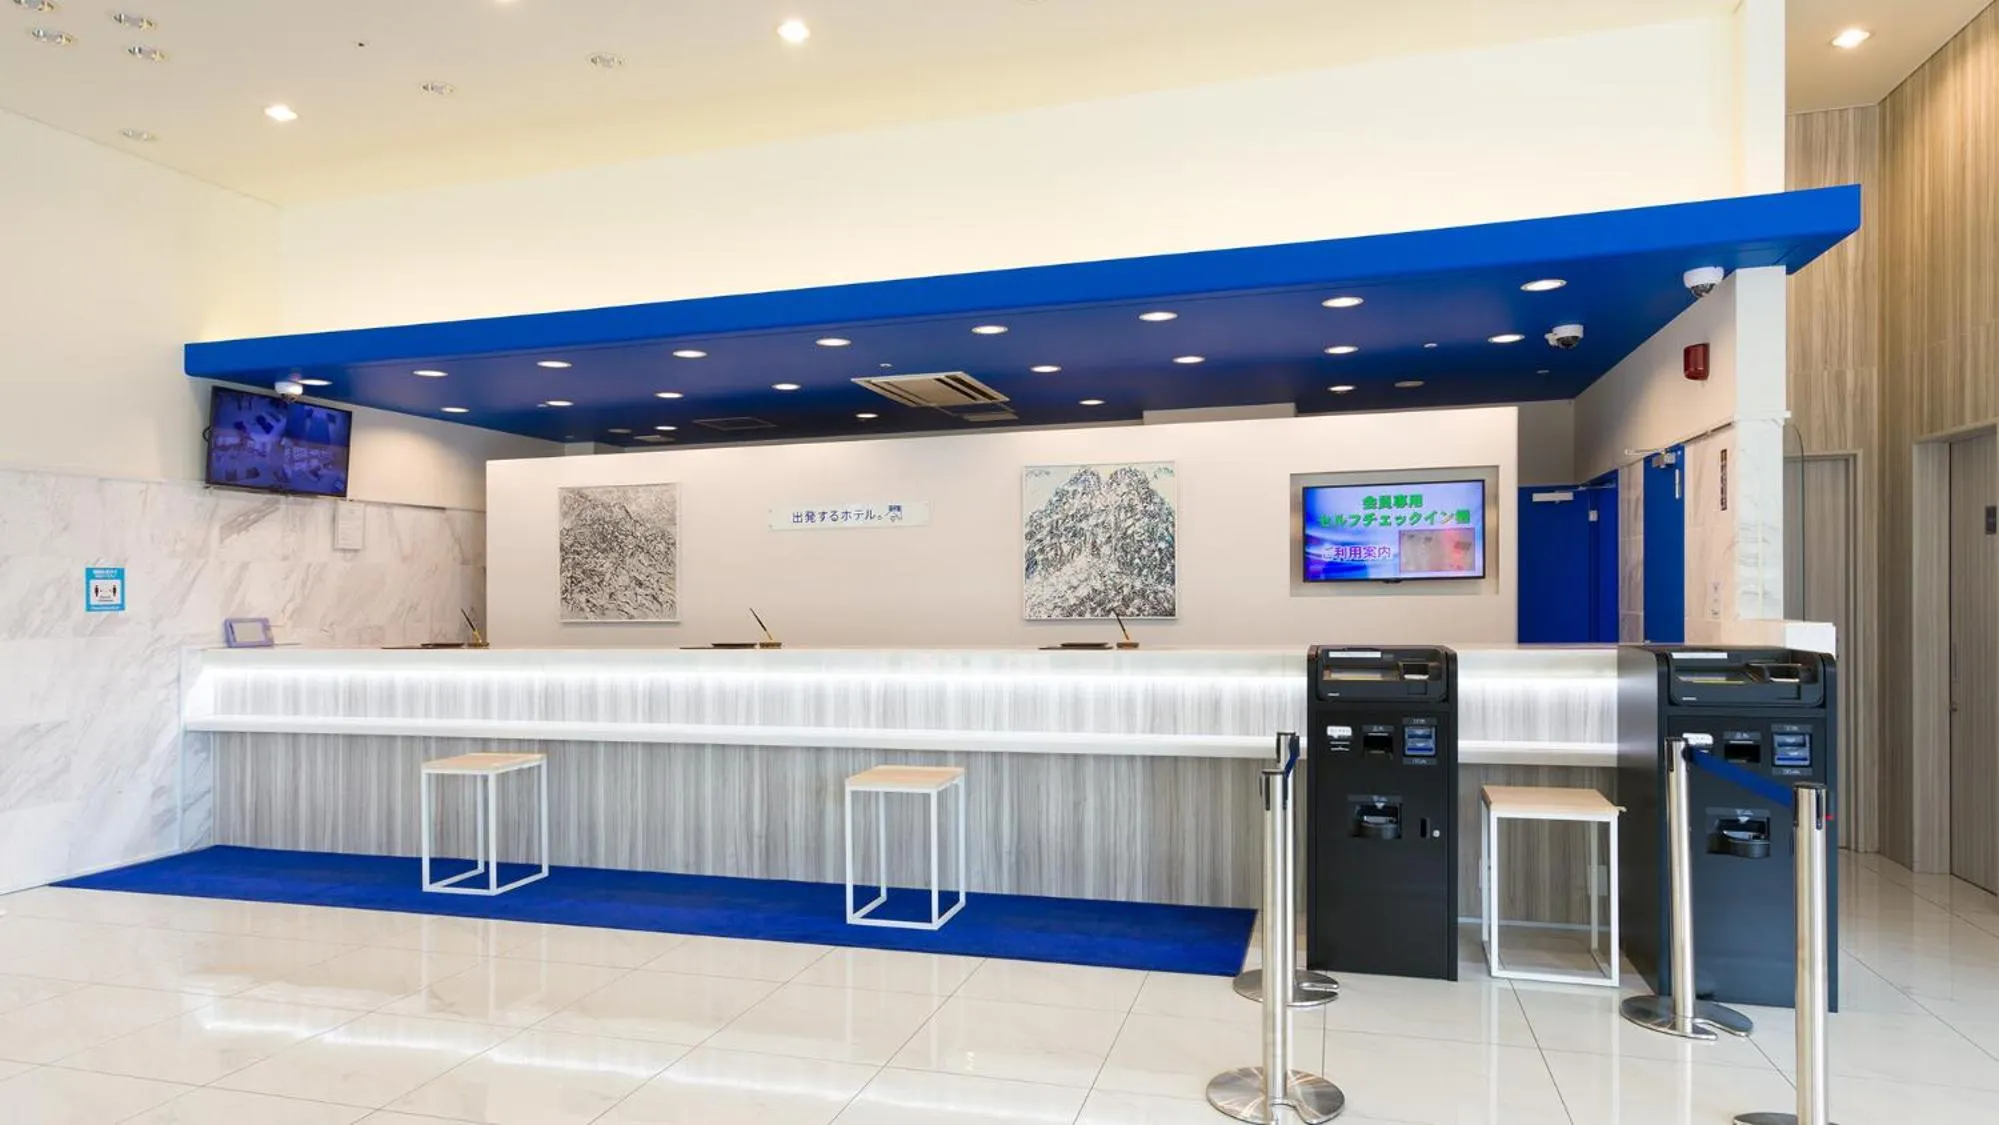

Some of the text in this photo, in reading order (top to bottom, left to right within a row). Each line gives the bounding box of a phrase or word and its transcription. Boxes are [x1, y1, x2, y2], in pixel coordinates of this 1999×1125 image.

[792, 509, 883, 524] 出発するホテル。
[1323, 546, 1391, 561] ご利用案内
